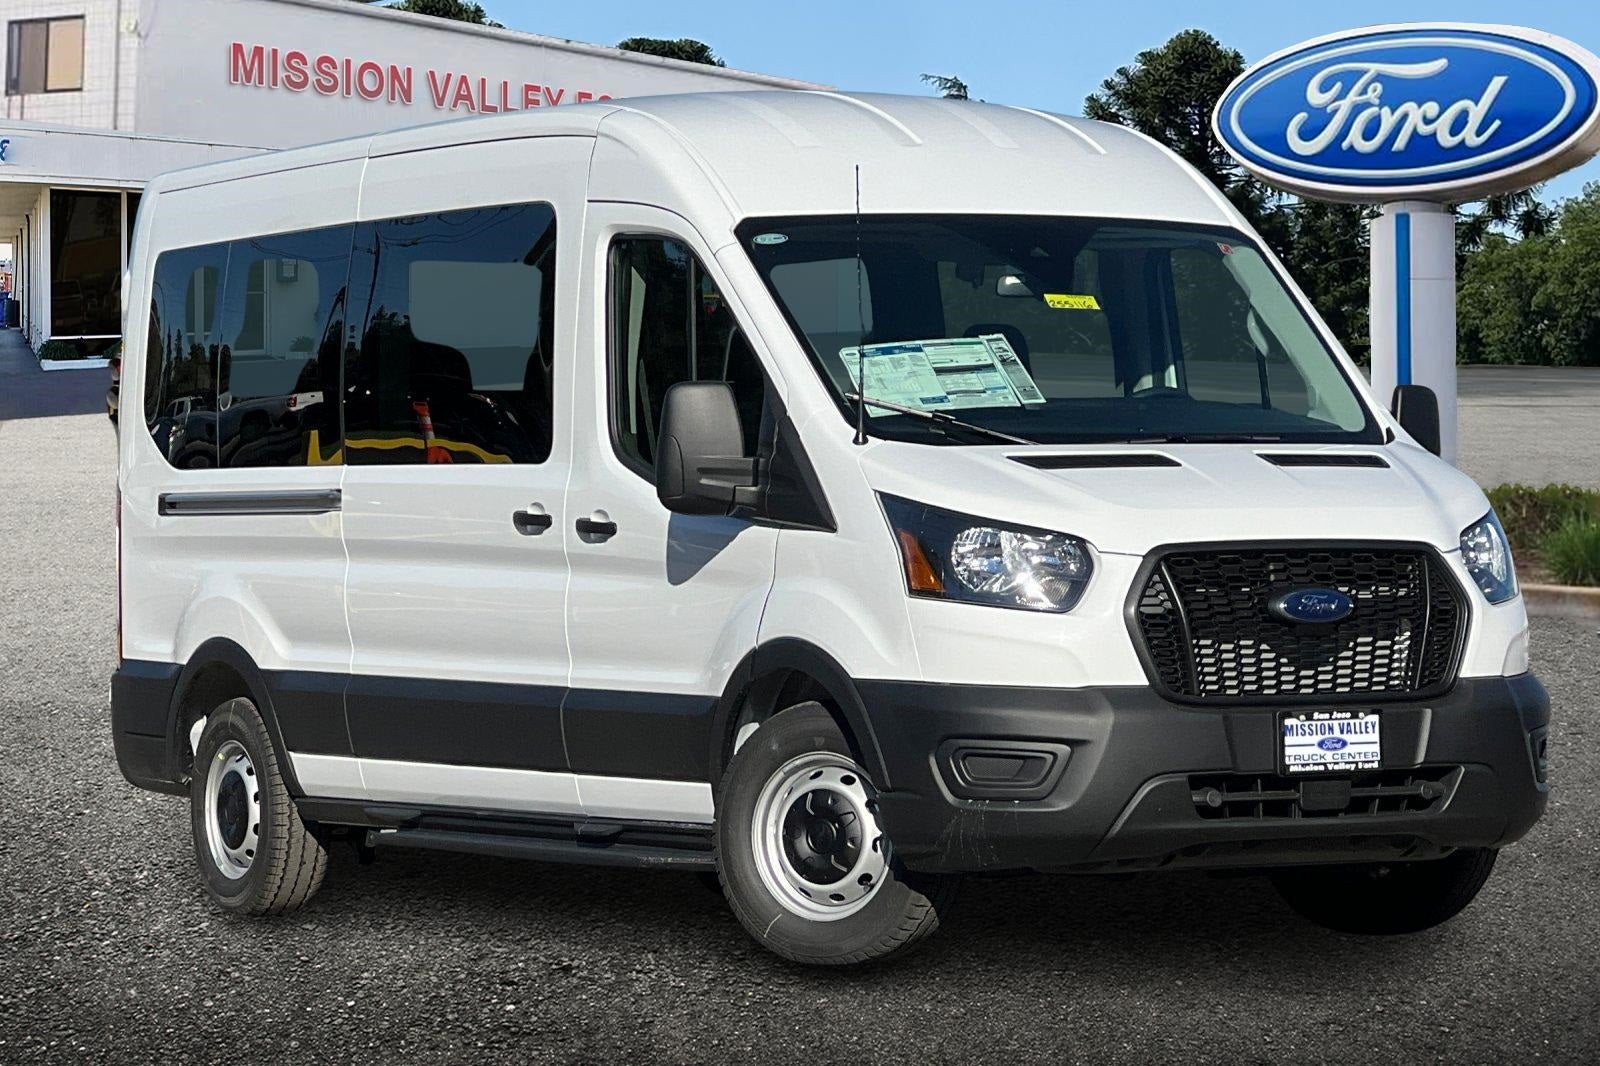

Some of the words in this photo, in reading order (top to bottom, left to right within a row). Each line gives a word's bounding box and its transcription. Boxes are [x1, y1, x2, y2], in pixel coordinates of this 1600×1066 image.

[229, 41, 414, 105] MISSION
[426, 69, 566, 114] VALLEY
[1286, 57, 1509, 156] Ford
[1284, 723, 1335, 737] MISSION
[1338, 721, 1377, 735] VALLEY
[1322, 739, 1342, 750] Ford
[1287, 753, 1327, 762] TRUCK
[1332, 751, 1379, 760] CENTER
[1327, 762, 1356, 771] Valley
